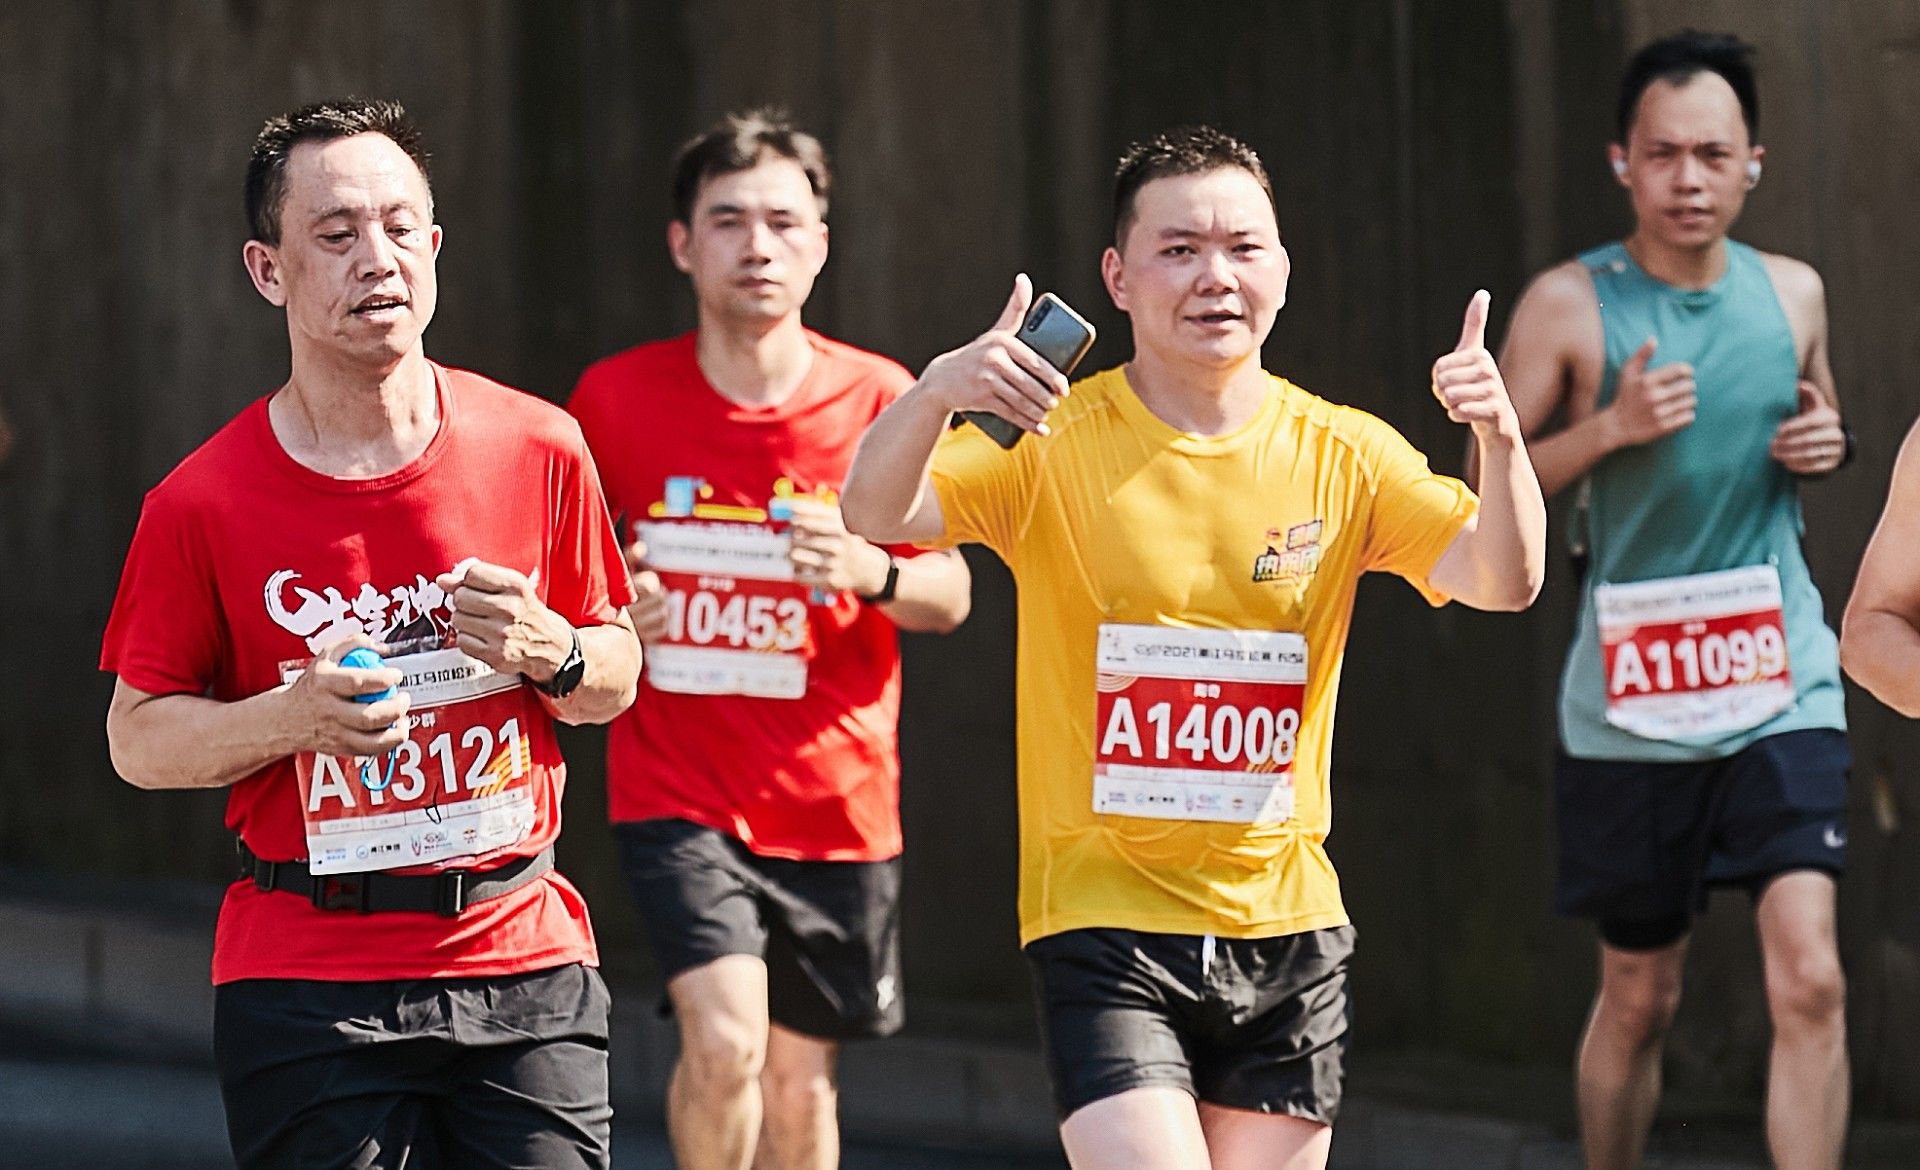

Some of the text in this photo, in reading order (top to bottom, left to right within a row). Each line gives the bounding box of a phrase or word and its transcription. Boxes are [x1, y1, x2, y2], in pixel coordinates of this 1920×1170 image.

[1611, 623, 1786, 695] A11099
[308, 718, 523, 812] A13121
[1100, 697, 1299, 765] A14008
